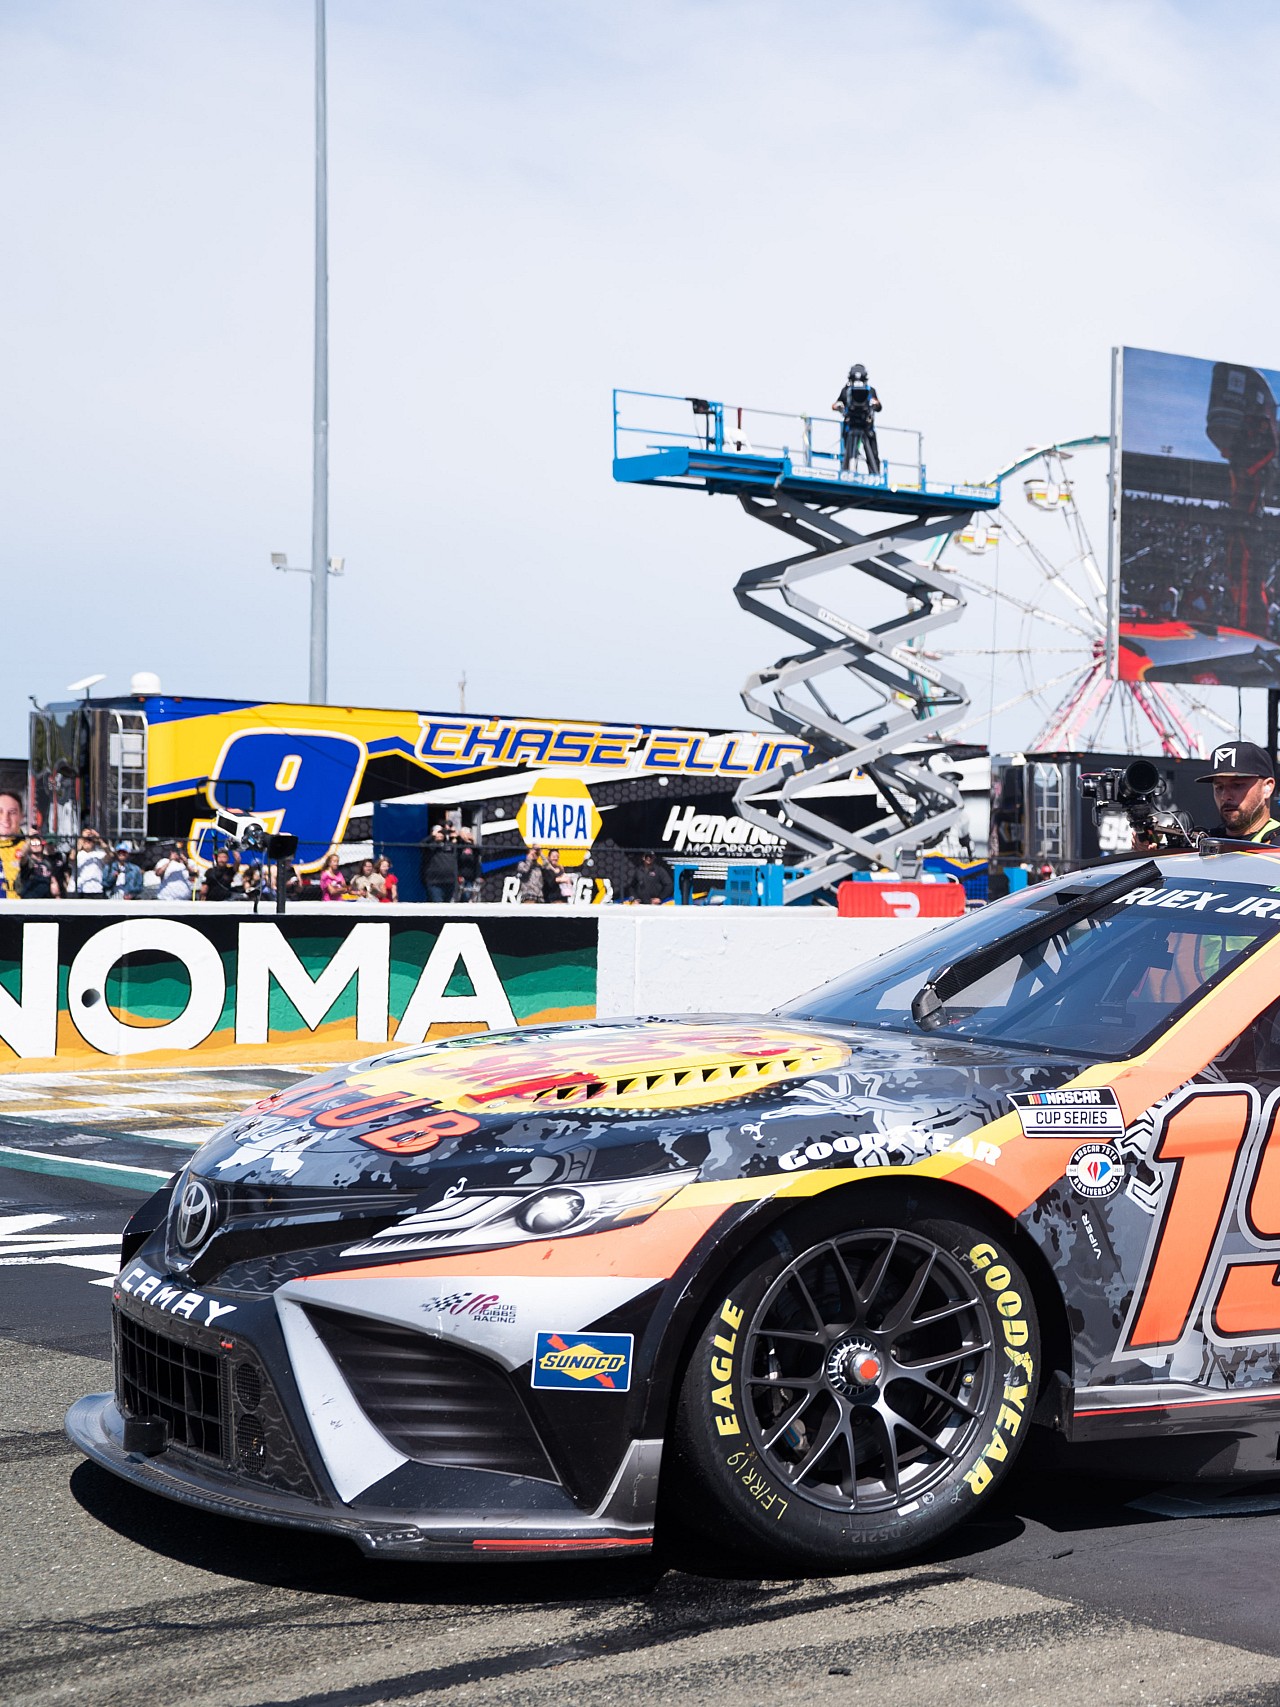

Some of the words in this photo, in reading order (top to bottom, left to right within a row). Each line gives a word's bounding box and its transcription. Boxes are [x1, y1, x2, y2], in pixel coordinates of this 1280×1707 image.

[418, 720, 641, 770] CHASE
[189, 728, 367, 873] 9
[532, 802, 588, 840] NAPA
[662, 805, 793, 852] Hendri
[684, 843, 787, 858] MOTORSPORTS
[1112, 886, 1229, 911] RUEX
[1045, 1090, 1101, 1105] NASCAR
[1035, 1111, 1064, 1125] CUP
[1065, 1110, 1108, 1125] SERIES
[494, 1146, 536, 1155] VIPER
[779, 1131, 1002, 1172] GOODYEAR
[1073, 1145, 1100, 1162] NASCAR
[1101, 1145, 1118, 1162] 75TH
[1073, 1176, 1118, 1196] ANNIVERSARY
[1081, 1213, 1102, 1260] VIPER
[473, 1315, 516, 1324] RACING
[482, 1310, 517, 1318] GIBBS
[544, 1354, 624, 1371] SUNOCO
[710, 1298, 744, 1437] EAGLE
[962, 1243, 1035, 1496] GOODYEAR
